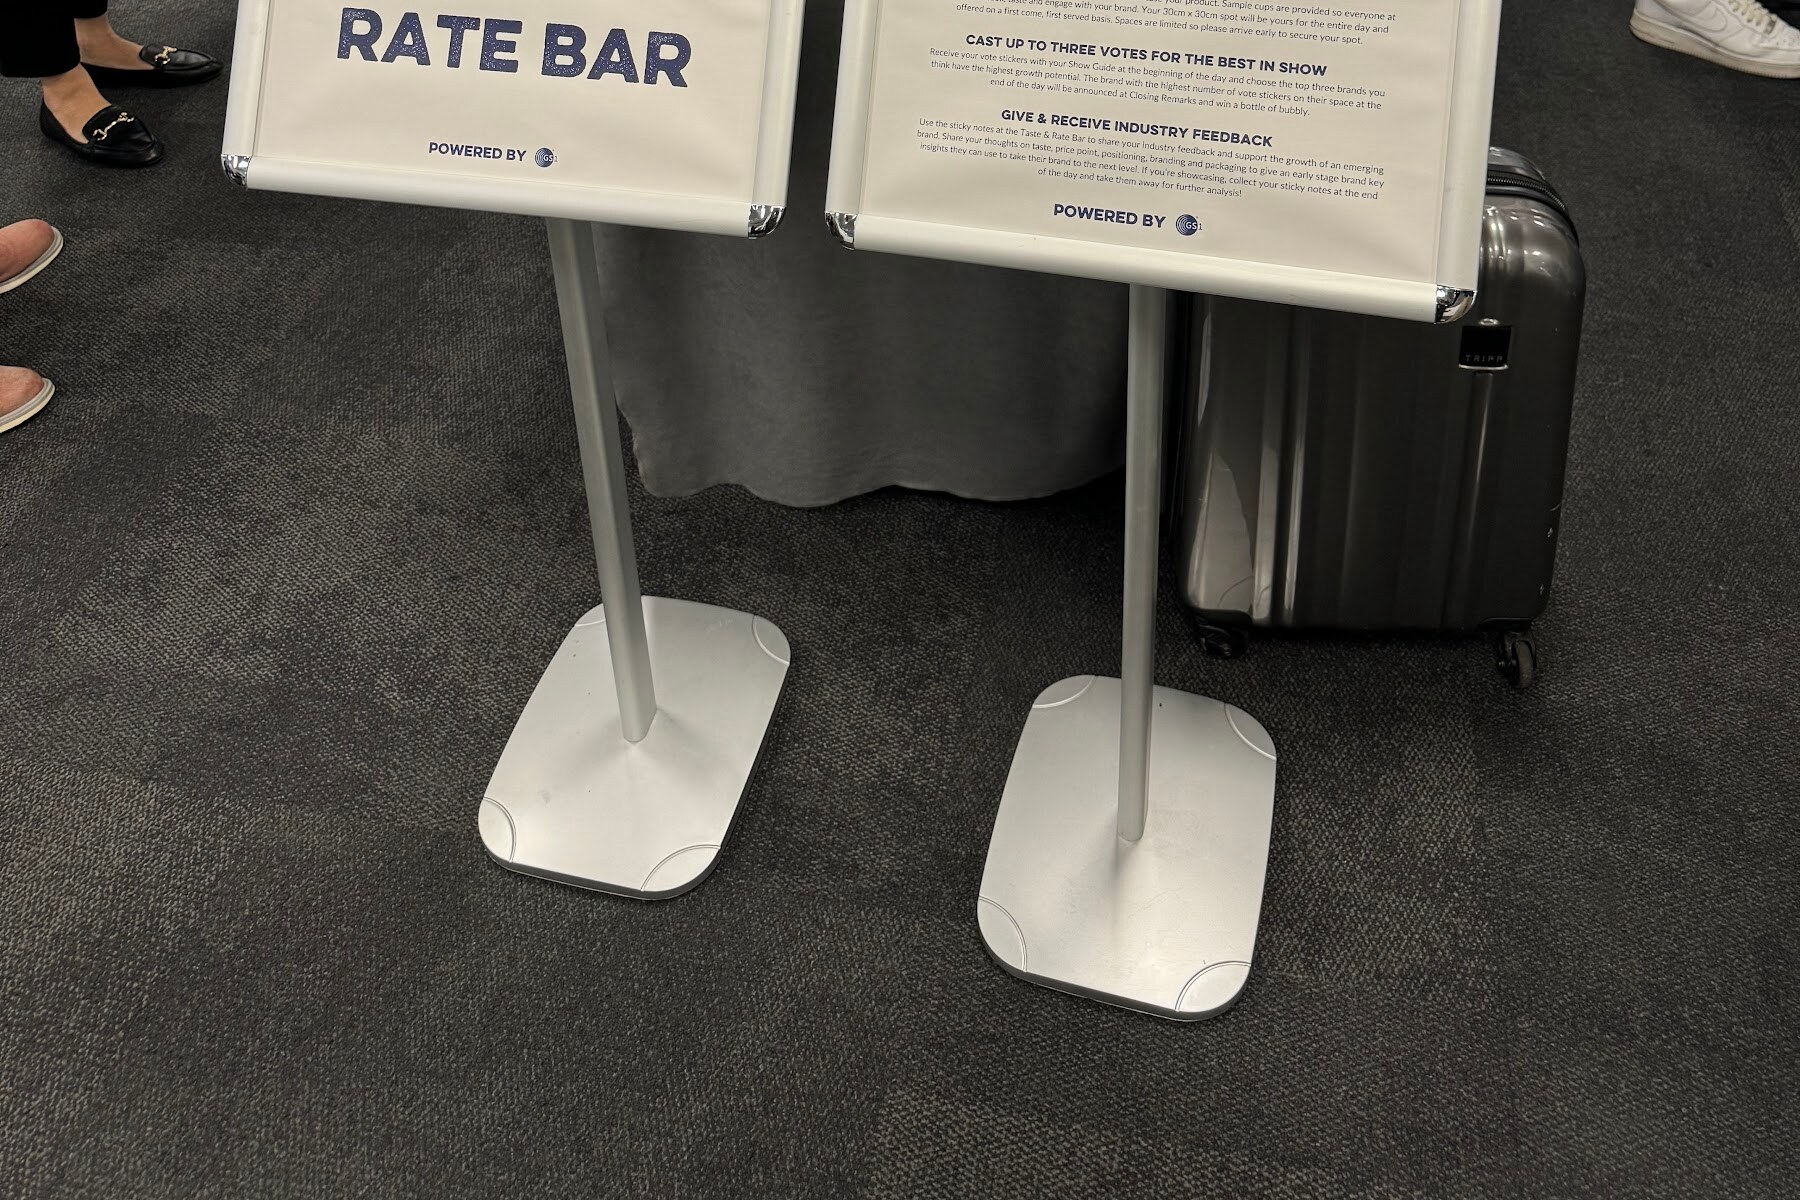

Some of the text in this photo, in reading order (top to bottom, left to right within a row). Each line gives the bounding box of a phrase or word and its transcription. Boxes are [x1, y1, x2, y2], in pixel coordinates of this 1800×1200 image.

[1044, 0, 1073, 9] engage
[1074, 0, 1092, 9] with
[1094, 3, 1112, 11] your
[1114, 2, 1138, 13] brand.
[1141, 5, 1161, 15] Your
[1162, 7, 1186, 17] 30cm
[1194, 9, 1218, 20] 30cm
[1219, 13, 1238, 22] spot
[1240, 13, 1255, 23] will
[1256, 14, 1268, 24] be
[1269, 17, 1294, 26] yours
[1295, 17, 1308, 27] for
[1310, 18, 1325, 28] the
[1326, 21, 1352, 31] entire
[1354, 22, 1371, 34] day
[1372, 25, 1389, 34] and
[1254, 3, 1274, 12] cups
[1275, 5, 1290, 13] are
[1291, 6, 1330, 16] provided
[1344, 10, 1385, 21] everyone
[336, 6, 692, 88] RATE BAR
[965, 34, 1327, 77] CAST UP TO THREE VOTES FOR THE BEST IN SHOW
[1001, 109, 1273, 148] GIVE & RECEIVE INDUSTRY FEEDBACK
[428, 141, 503, 159] POWERED
[506, 148, 527, 162] BY
[1053, 203, 1138, 225] POWERED
[1142, 213, 1166, 228] BY
[1465, 354, 1503, 362] TRIPP
